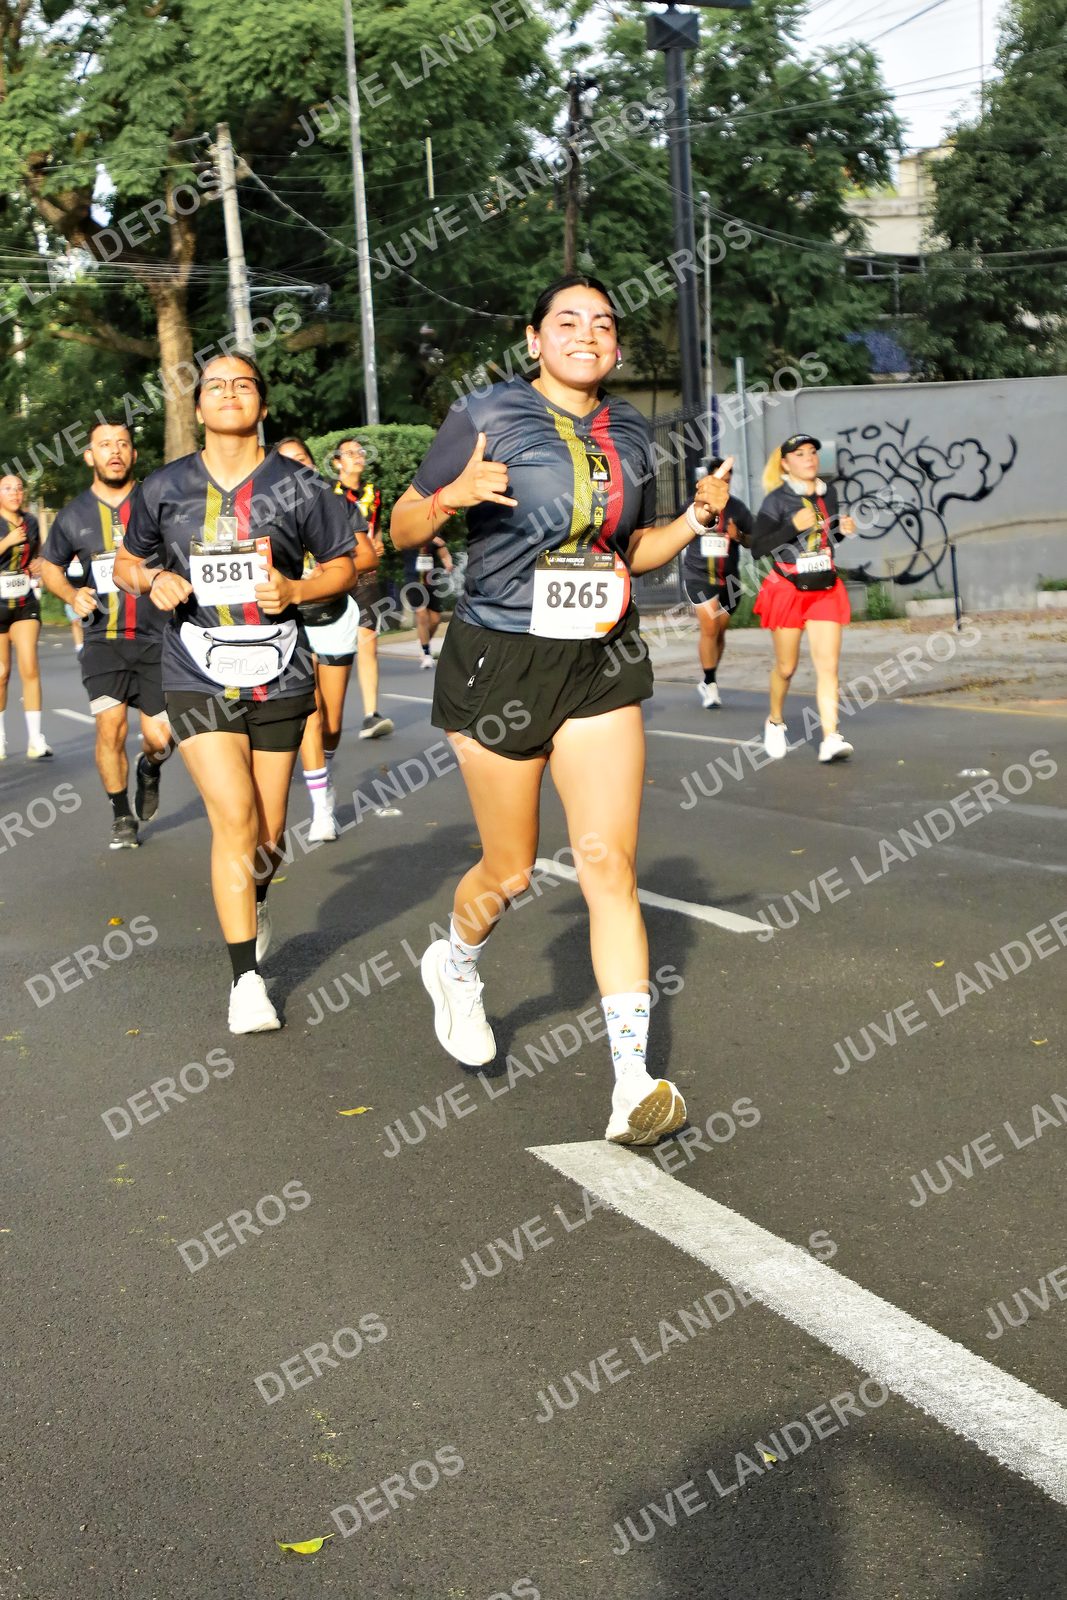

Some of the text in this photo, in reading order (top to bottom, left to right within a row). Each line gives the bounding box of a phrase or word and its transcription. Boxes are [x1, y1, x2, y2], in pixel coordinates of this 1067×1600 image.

[838, 418, 910, 447] TOY
[201, 561, 254, 583] 8581
[546, 581, 608, 608] 8265
[217, 657, 270, 675] FILA
